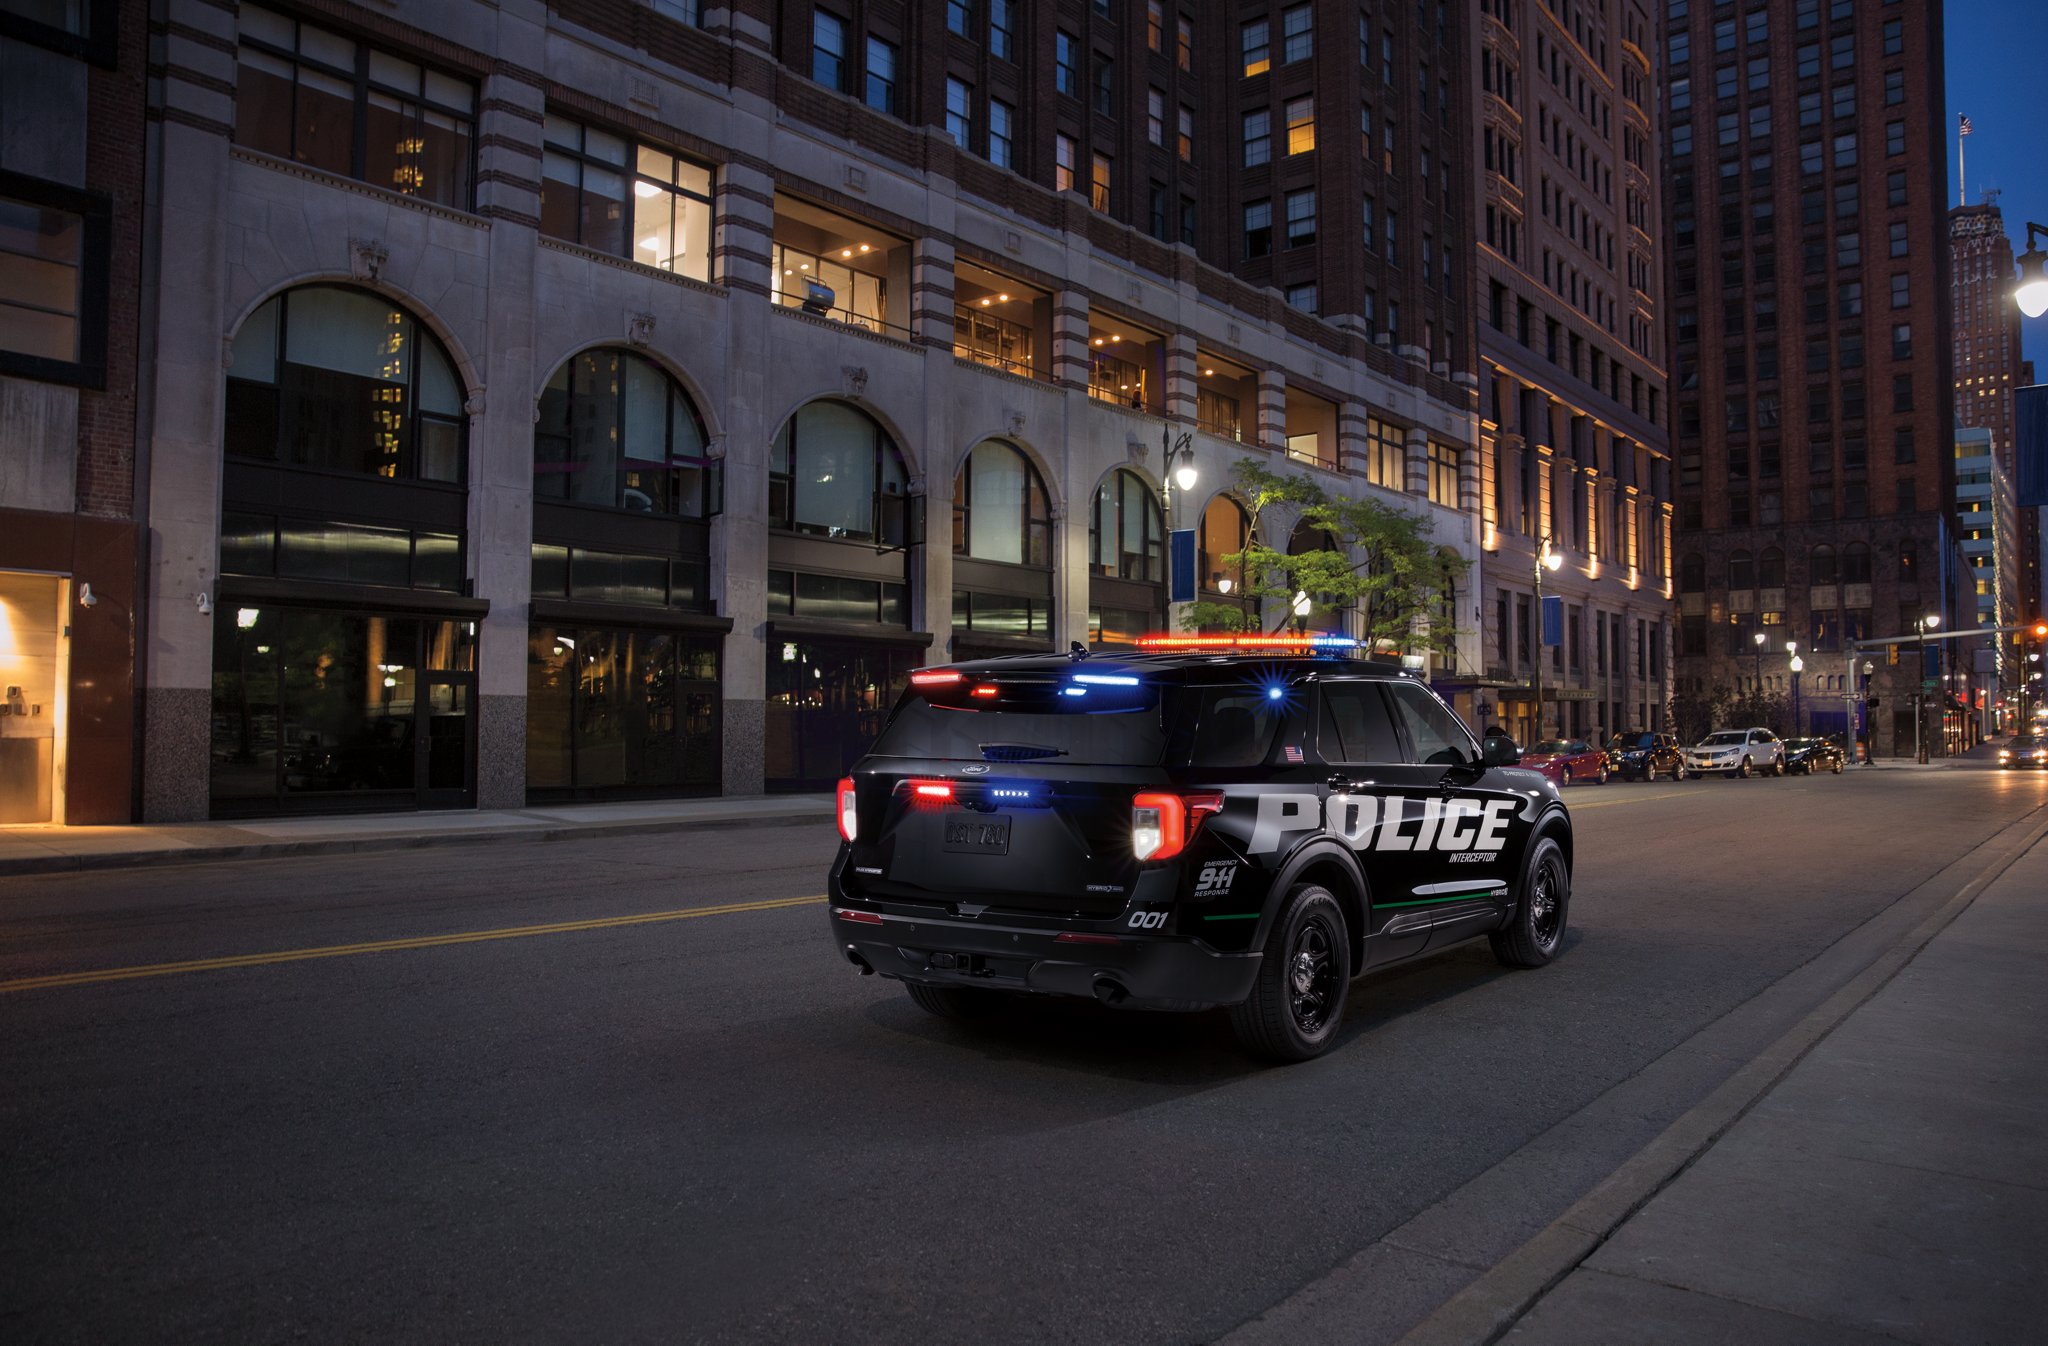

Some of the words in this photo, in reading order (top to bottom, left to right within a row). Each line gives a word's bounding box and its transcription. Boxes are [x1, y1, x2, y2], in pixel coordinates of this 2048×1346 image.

[1246, 793, 1517, 855] POLICE
[1448, 852, 1498, 863] INTERCEPTOR
[1204, 859, 1239, 868] EMERGENCY
[1194, 888, 1230, 898] RESPONSE
[1127, 911, 1169, 929] 001
